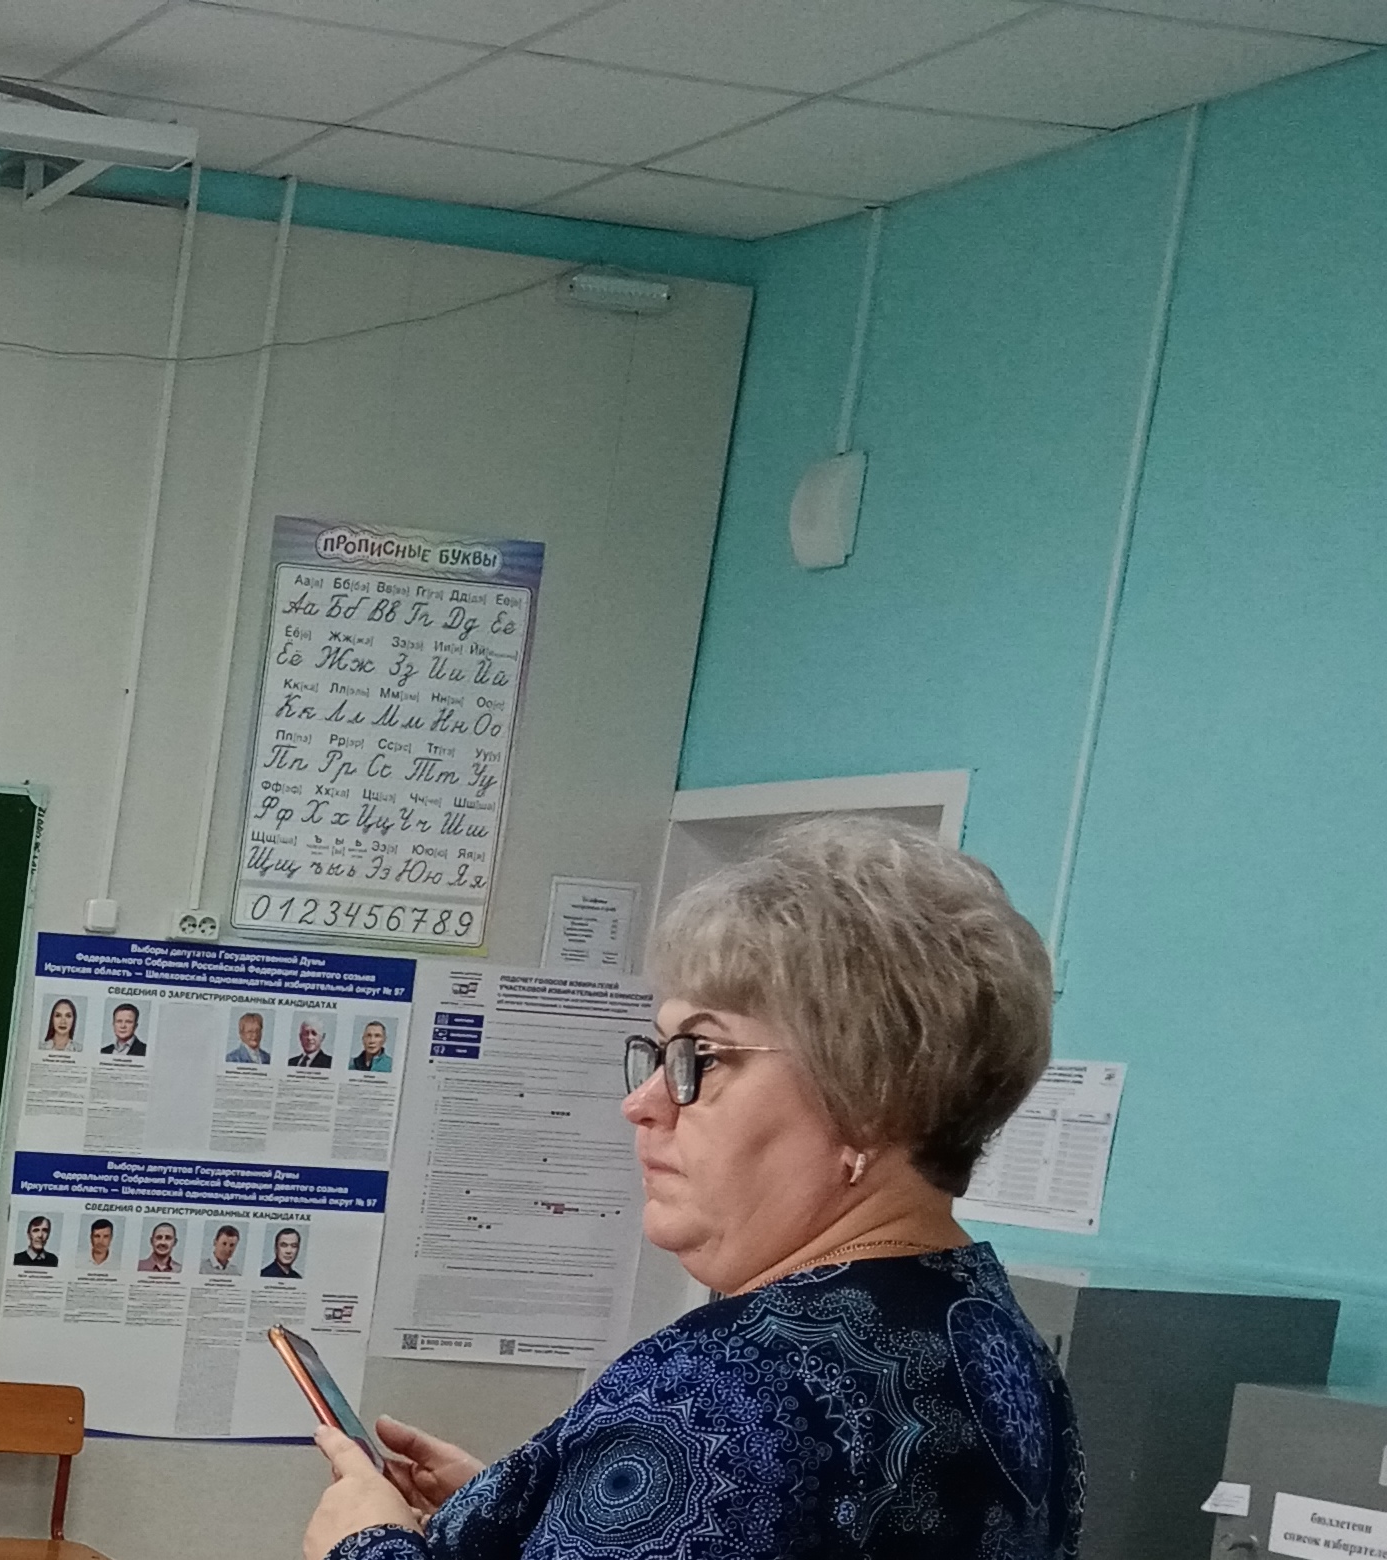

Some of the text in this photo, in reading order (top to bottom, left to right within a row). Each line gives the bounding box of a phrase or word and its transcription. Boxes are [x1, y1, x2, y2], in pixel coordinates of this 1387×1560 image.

[323, 534, 497, 567] ПРОПИСНЫЕ БУКВЫ
[251, 895, 473, 936] 0 1 2 3 4 5 6 7 8 9
[131, 944, 325, 967] Выборы депутатов Государственной Думы
[108, 987, 337, 1009] СВЕДЕНИЯ О ЗАРЕГИСТРИРОВАННЫХ КАНДИДАТАХ
[85, 1203, 133, 1212] СВЕДЕНИЯ
[144, 1206, 250, 1218] ЗАРЕГИСТРИРОВАННЫХ
[253, 1212, 311, 1221] КАНДИДАТАХ
[1311, 1513, 1372, 1534] бюллетени
[1284, 1532, 1321, 1546] список
